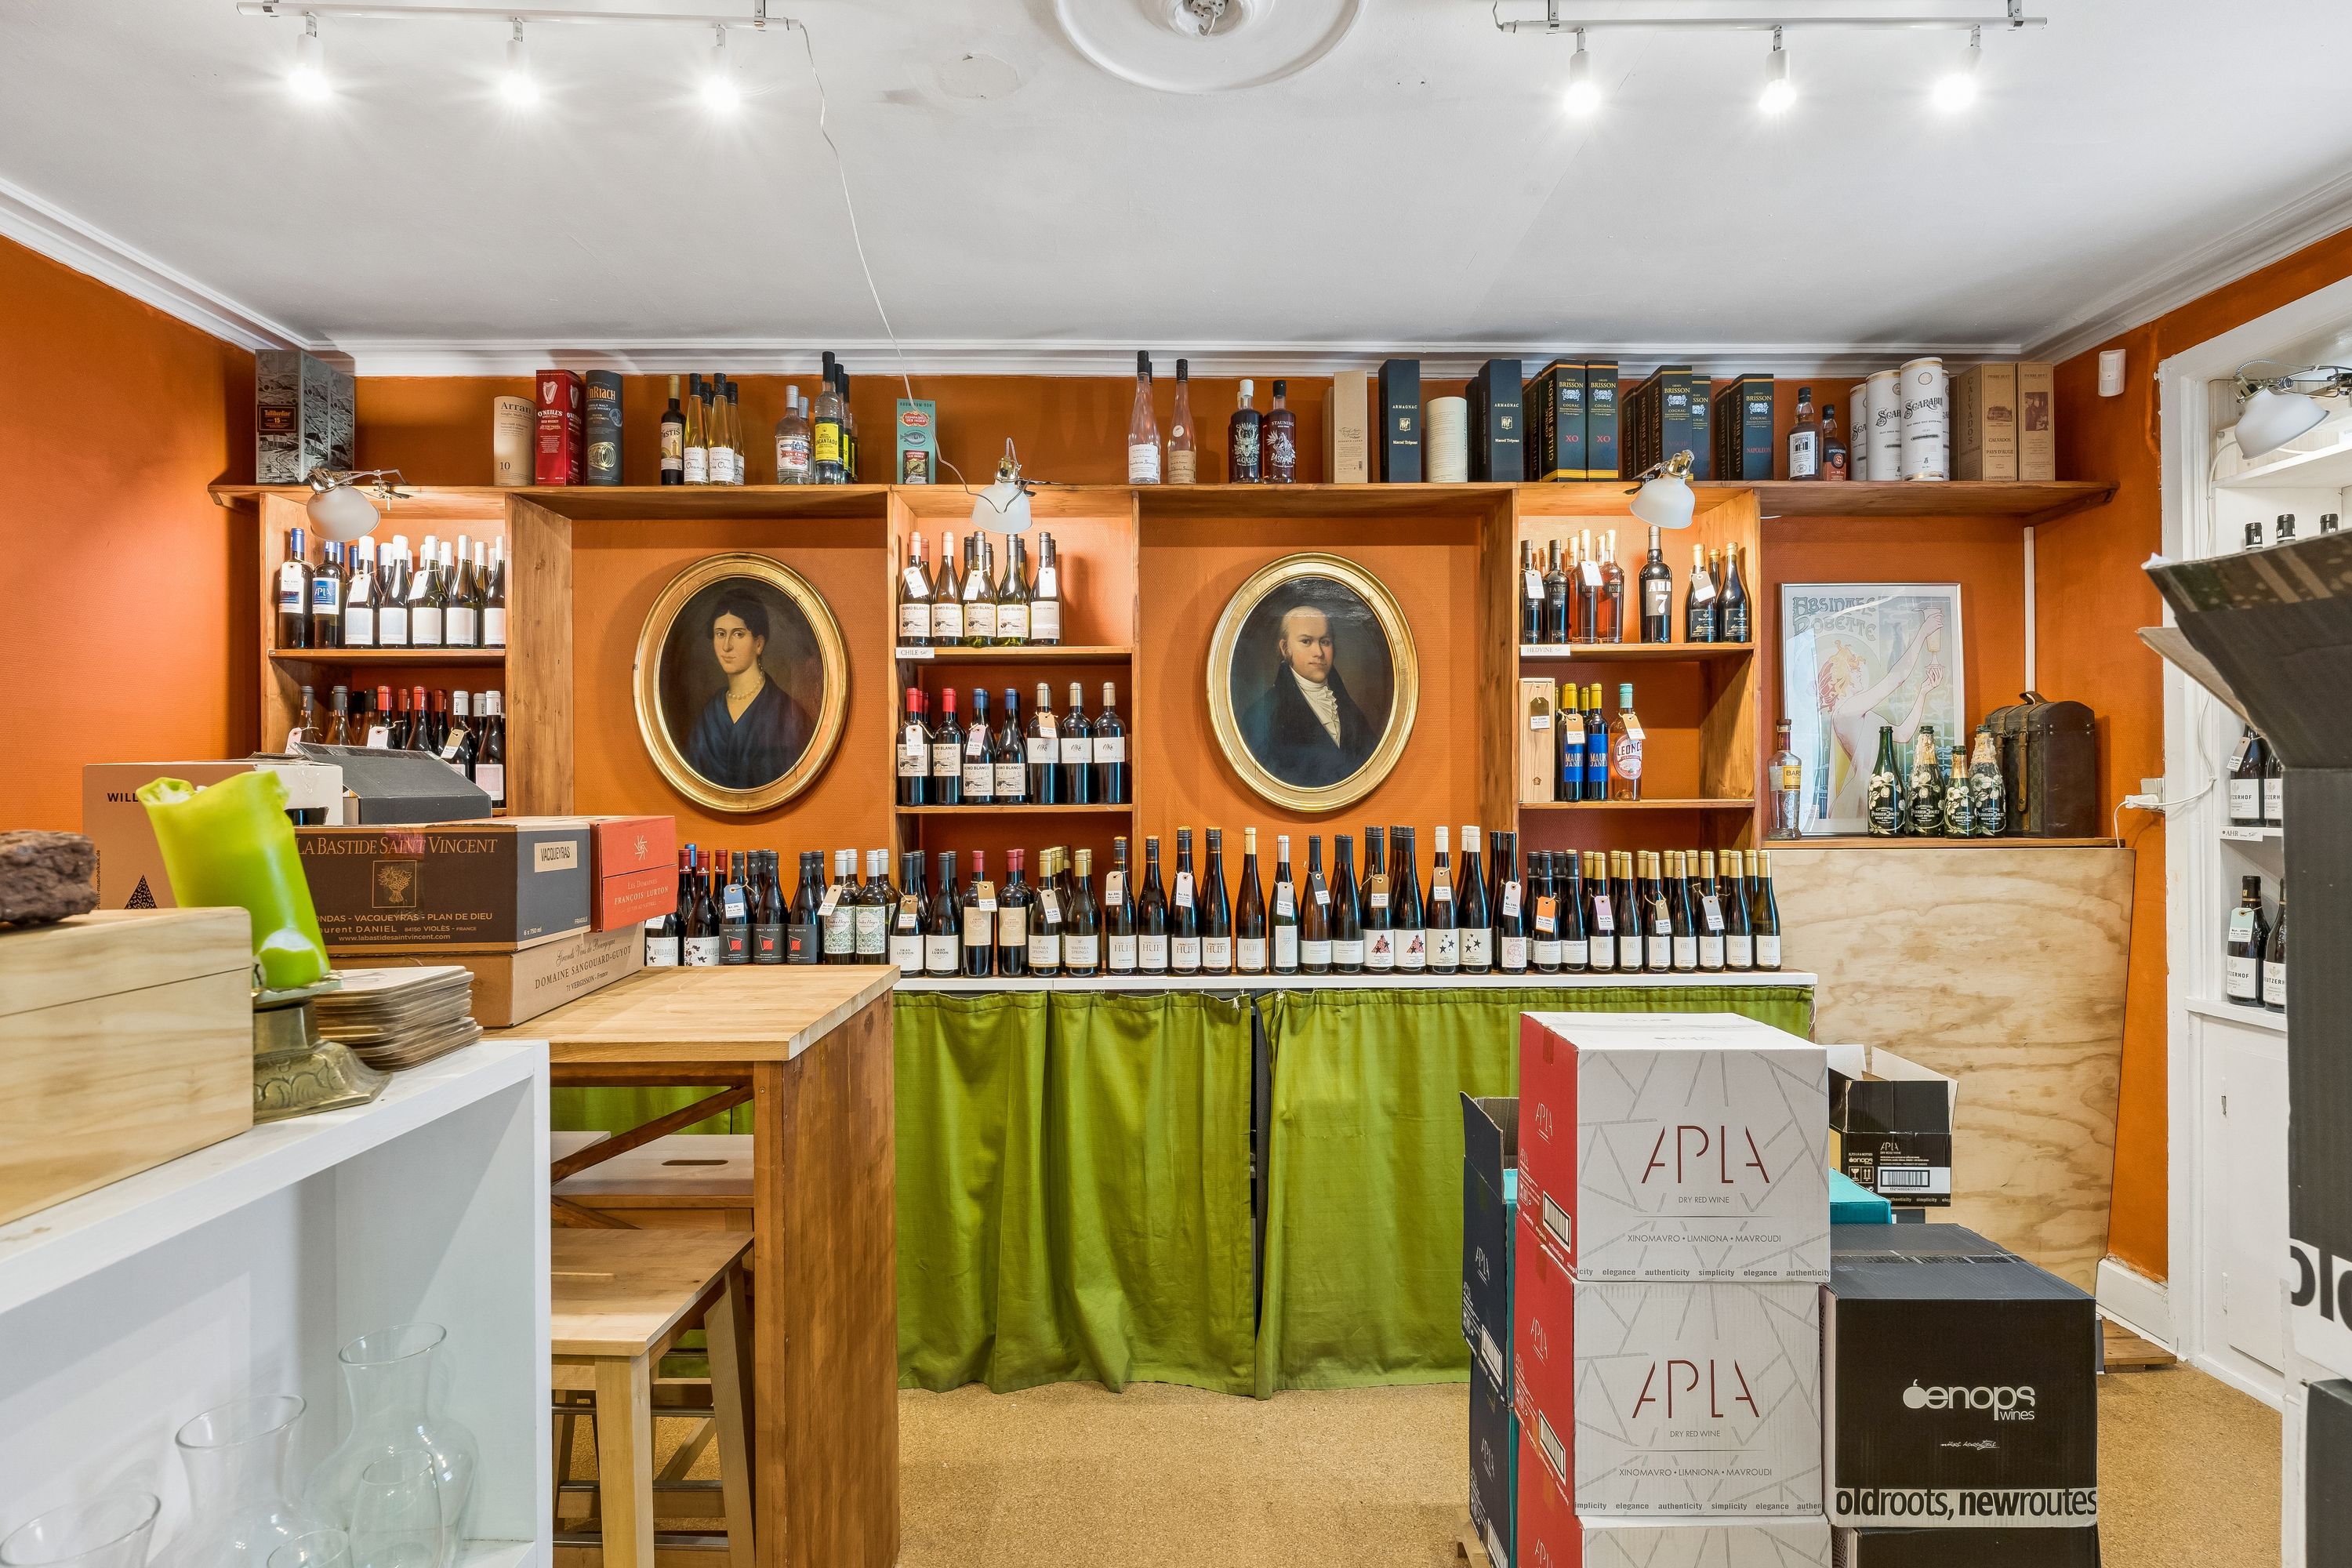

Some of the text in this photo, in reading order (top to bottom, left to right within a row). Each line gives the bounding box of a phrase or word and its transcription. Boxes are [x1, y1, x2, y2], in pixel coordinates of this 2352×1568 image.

[501, 401, 531, 414] Arran
[499, 462, 510, 470] 10
[314, 587, 332, 597] APLA
[1648, 581, 1672, 592] AHR
[1655, 593, 1668, 614] 7
[107, 793, 141, 803] WILL
[296, 836, 498, 855] LA BASTIDE SAINT VINCENT
[540, 846, 571, 862] VACQUEYRAS
[614, 886, 669, 906] FRANÇOIS LURTON
[354, 914, 419, 923] VACQUEYRAS
[574, 916, 588, 925] FRAGILE
[535, 946, 631, 989] DOMAINE SANGOUARD-GUYOT
[571, 976, 595, 991] VERGISSON
[597, 971, 608, 981] France
[1535, 1102, 1553, 1137] APLA
[1880, 1142, 1900, 1151] APLA
[1641, 1125, 1770, 1184] APLA
[1628, 1234, 1781, 1243] XINOMAVRO LIMNIONA MAVROUDI
[1475, 1245, 1490, 1280] APLA
[1602, 1268, 1830, 1277] elegance authenticity simplicity elegance authenticity
[1530, 1317, 1548, 1360] APLA
[1632, 1359, 1760, 1419] APLA
[1999, 1410, 2035, 1421] wines
[1726, 1468, 1772, 1476] MAVROUDI
[1574, 1501, 1607, 1510] implicity
[1658, 1501, 1703, 1510] authenticity
[1711, 1501, 1748, 1510] simplicity
[1835, 1488, 2097, 1520] oldroots, newroutes
